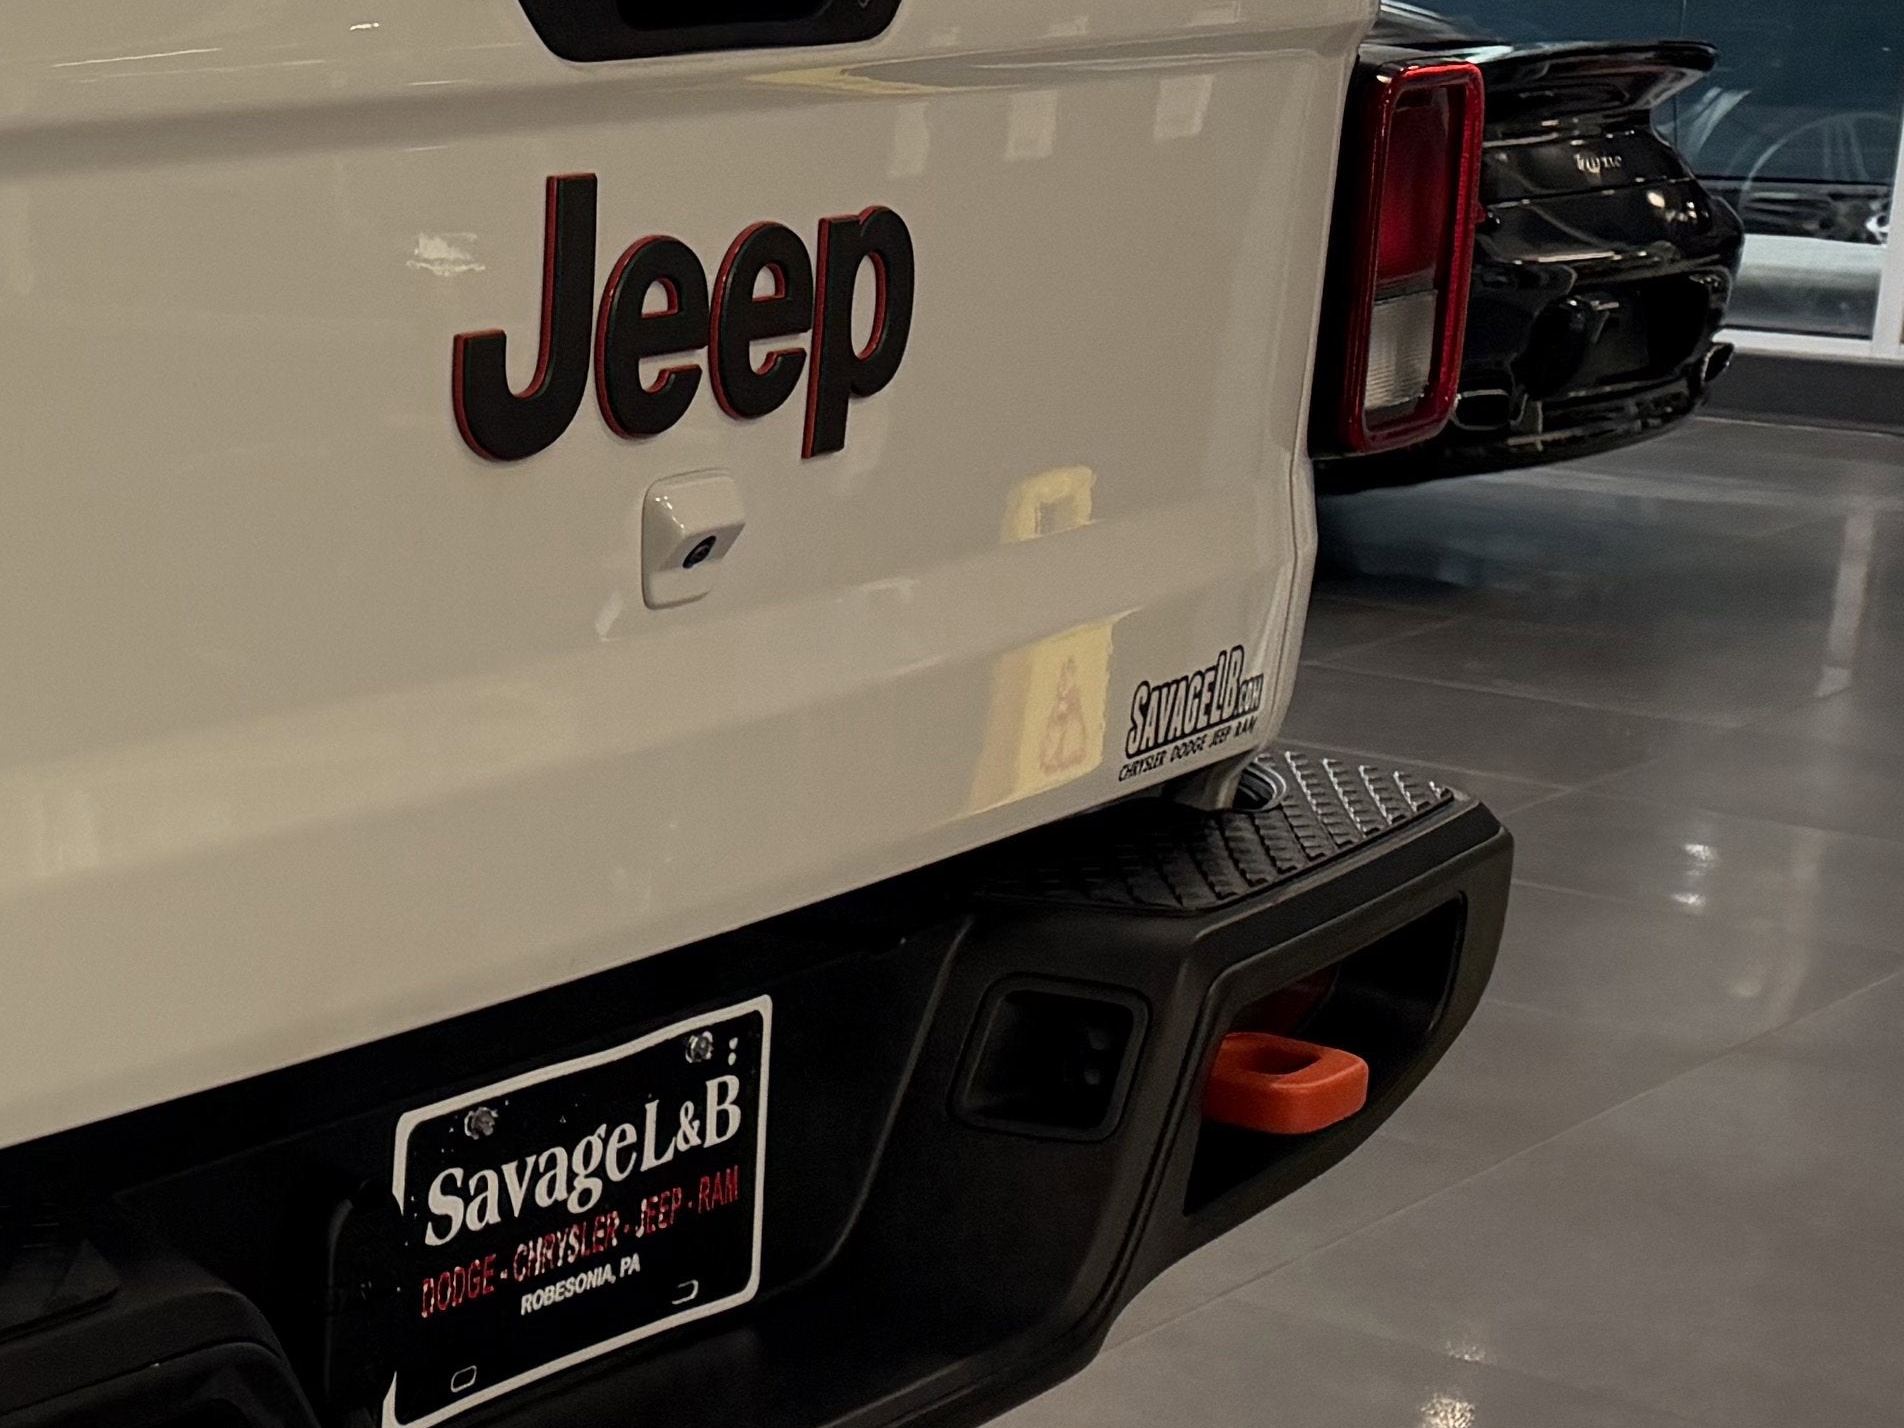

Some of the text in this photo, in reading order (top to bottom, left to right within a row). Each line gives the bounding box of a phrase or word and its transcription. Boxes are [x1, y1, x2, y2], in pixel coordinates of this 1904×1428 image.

[452, 172, 916, 462] Jeep
[1118, 715, 1258, 782] CHRYSLER DODGE JEEP RAM
[424, 1074, 742, 1246] SavageL&B
[421, 1253, 497, 1318] DODGE
[513, 1210, 620, 1282] CHRYSLER
[635, 1187, 682, 1238] JEEP
[698, 1164, 738, 1214] RAM
[520, 1252, 641, 1316] ROBESONIA, PA
